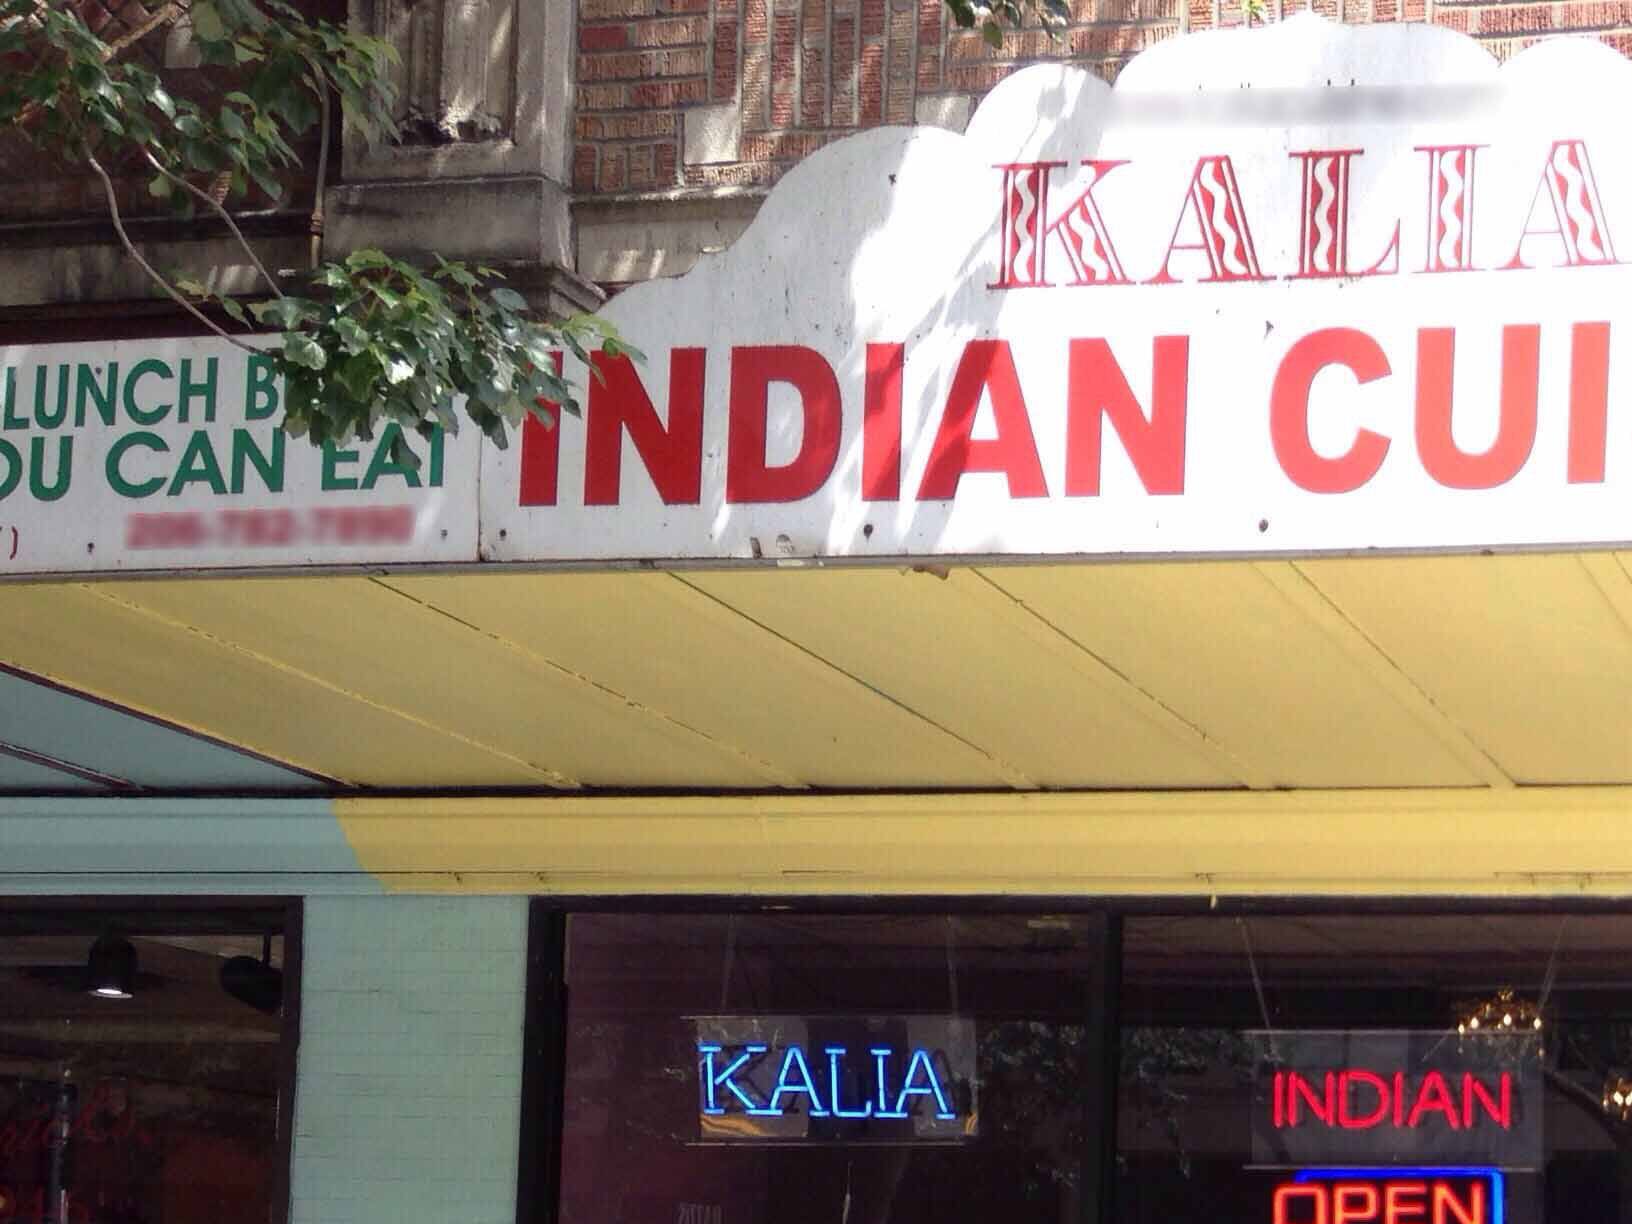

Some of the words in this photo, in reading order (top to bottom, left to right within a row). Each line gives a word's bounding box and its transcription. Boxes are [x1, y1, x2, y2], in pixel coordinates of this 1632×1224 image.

[986, 139, 1632, 290] KALIA
[3, 357, 219, 431] LUNCH
[518, 335, 1191, 507] INDIAN
[105, 428, 285, 499] CAN
[698, 1043, 955, 1119] KALIA
[1273, 1070, 1512, 1131] INDIAN
